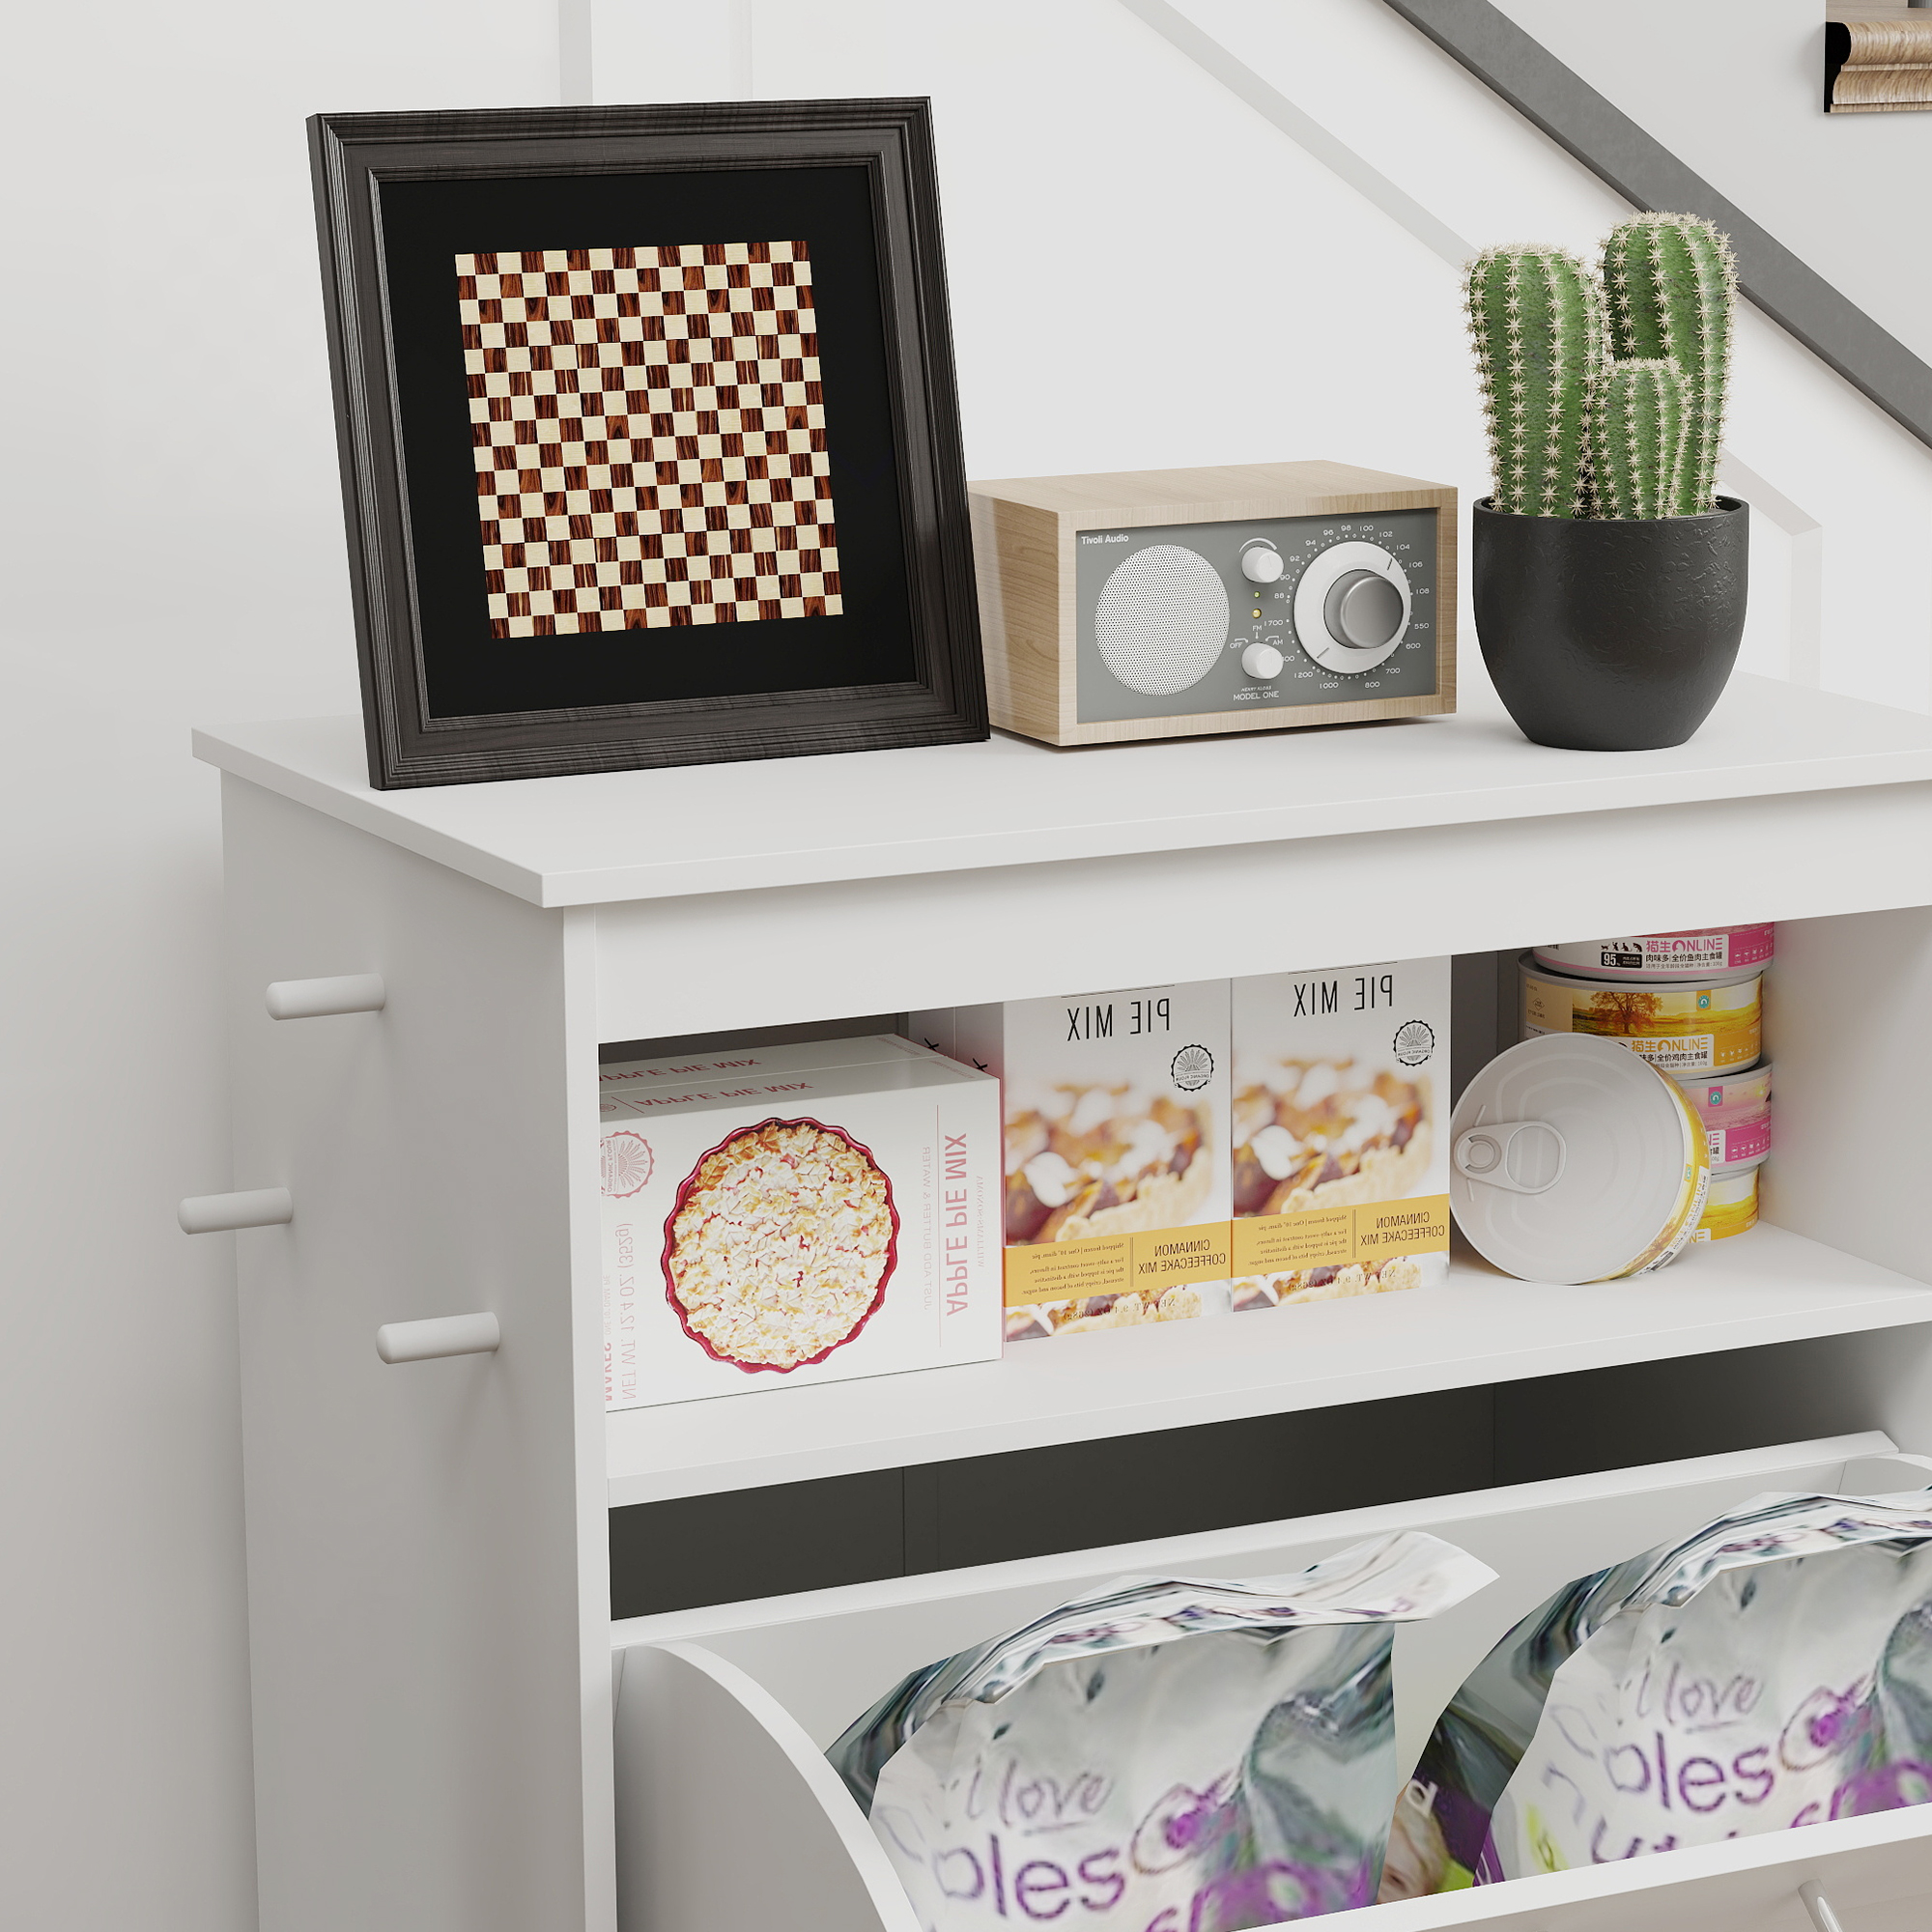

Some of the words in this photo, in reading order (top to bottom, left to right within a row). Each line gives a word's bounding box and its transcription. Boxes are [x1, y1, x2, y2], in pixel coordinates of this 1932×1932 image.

[1081, 535, 1103, 545] Tivoli
[1104, 534, 1129, 544] Audio
[1233, 693, 1261, 701] MODEL
[1664, 1662, 1764, 1726] love
[999, 1758, 1114, 1829] love
